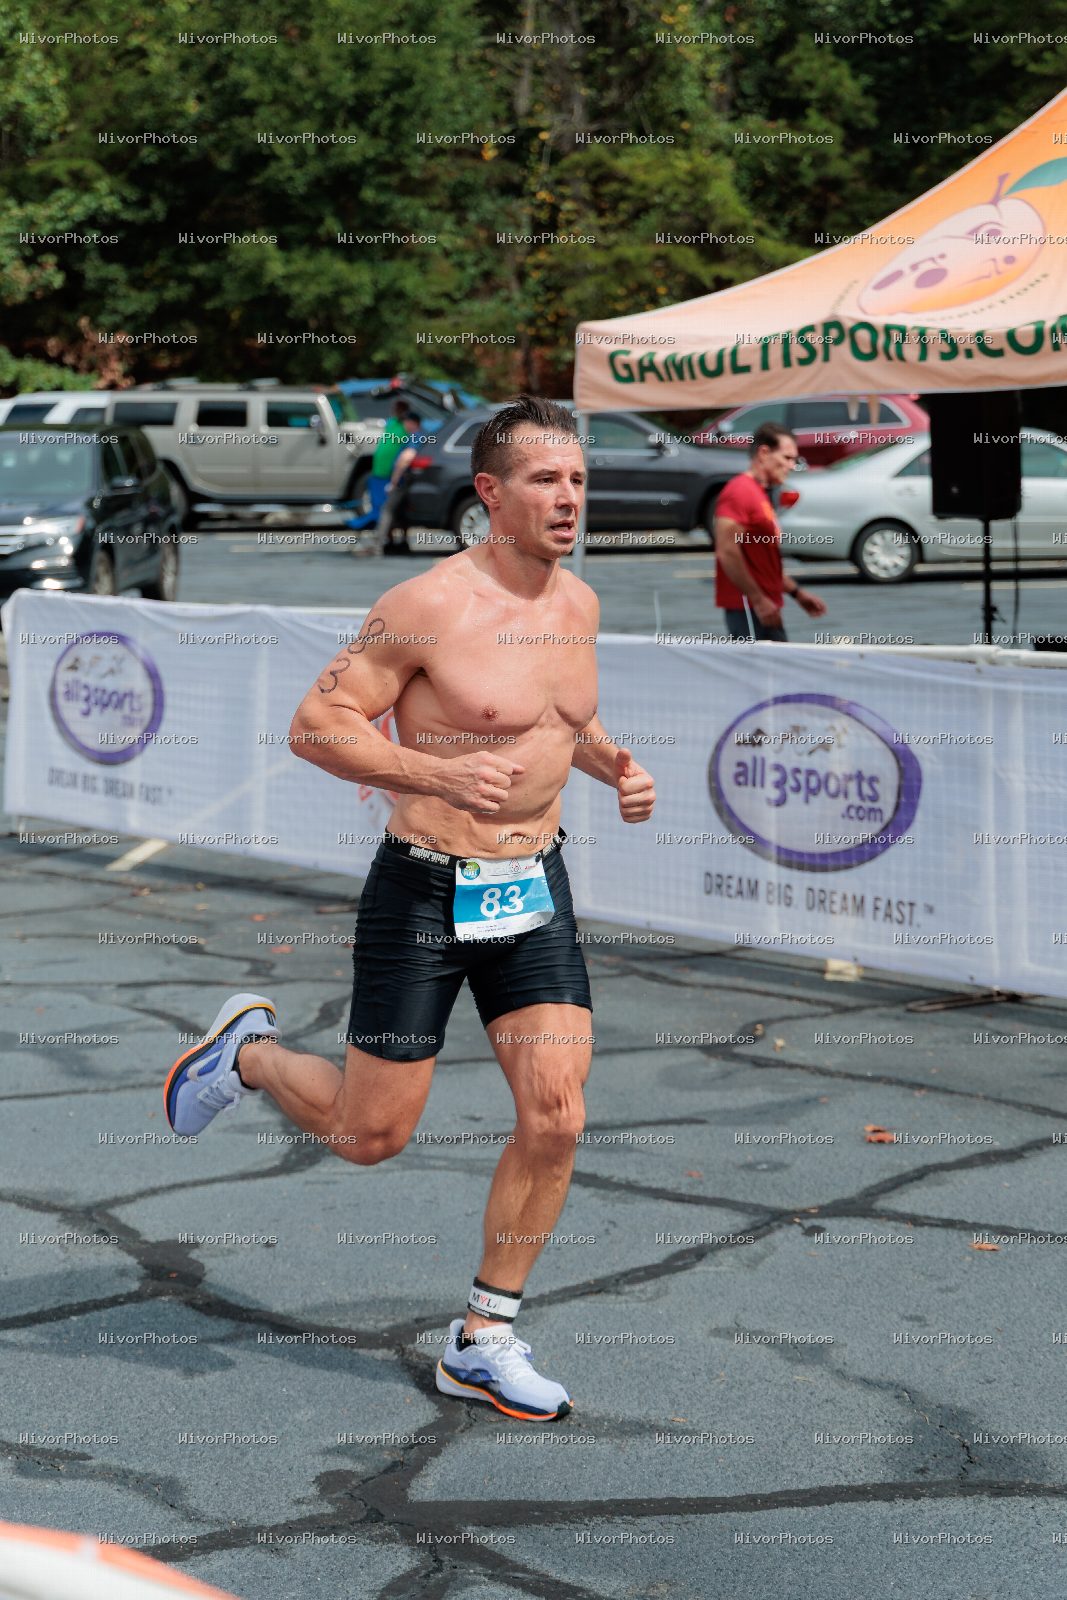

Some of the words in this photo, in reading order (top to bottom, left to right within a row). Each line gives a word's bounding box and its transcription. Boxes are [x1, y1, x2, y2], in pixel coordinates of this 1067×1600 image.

[733, 755, 880, 807] all3sports
[841, 804, 884, 823] .com
[480, 884, 524, 918] 83
[703, 871, 759, 900] DREAM
[805, 887, 865, 918] DREAM
